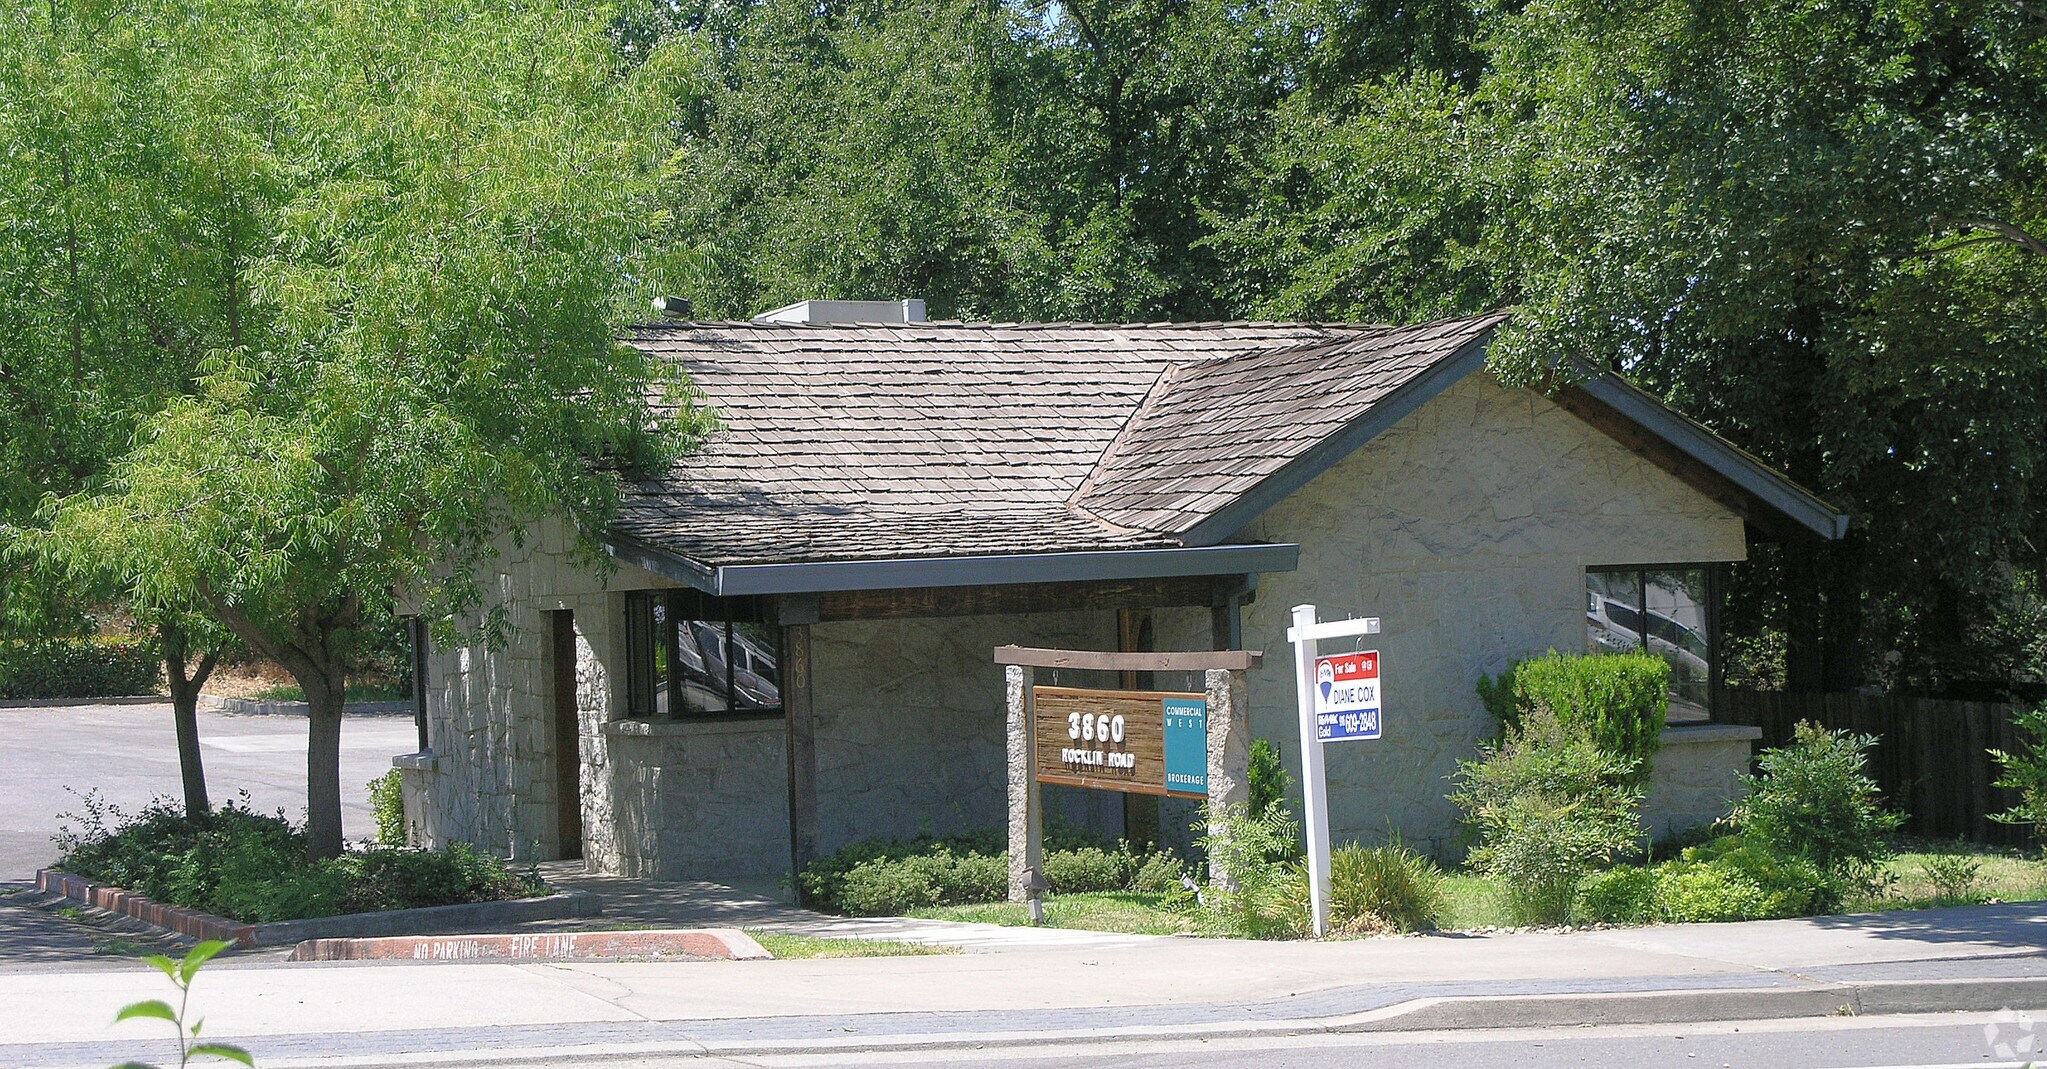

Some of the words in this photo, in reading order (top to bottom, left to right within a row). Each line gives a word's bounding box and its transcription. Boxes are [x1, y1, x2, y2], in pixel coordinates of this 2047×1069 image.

[1335, 663, 1344, 674] For
[1345, 662, 1356, 673] Sale
[1334, 688, 1355, 705] DIANE
[1358, 686, 1375, 702] COX
[1166, 706, 1203, 717] COMMERCIAL
[1068, 712, 1125, 743] 3860
[1318, 725, 1331, 737] Gold
[1345, 711, 1376, 733] 609-2848
[1061, 748, 1104, 766] ROCKLIN
[1108, 752, 1136, 768] ROAD
[1167, 773, 1204, 786] BROKERAGE
[414, 942, 429, 960] NO
[432, 940, 479, 960] PARKING
[511, 936, 538, 959] FIRE
[546, 935, 578, 958] LANE
